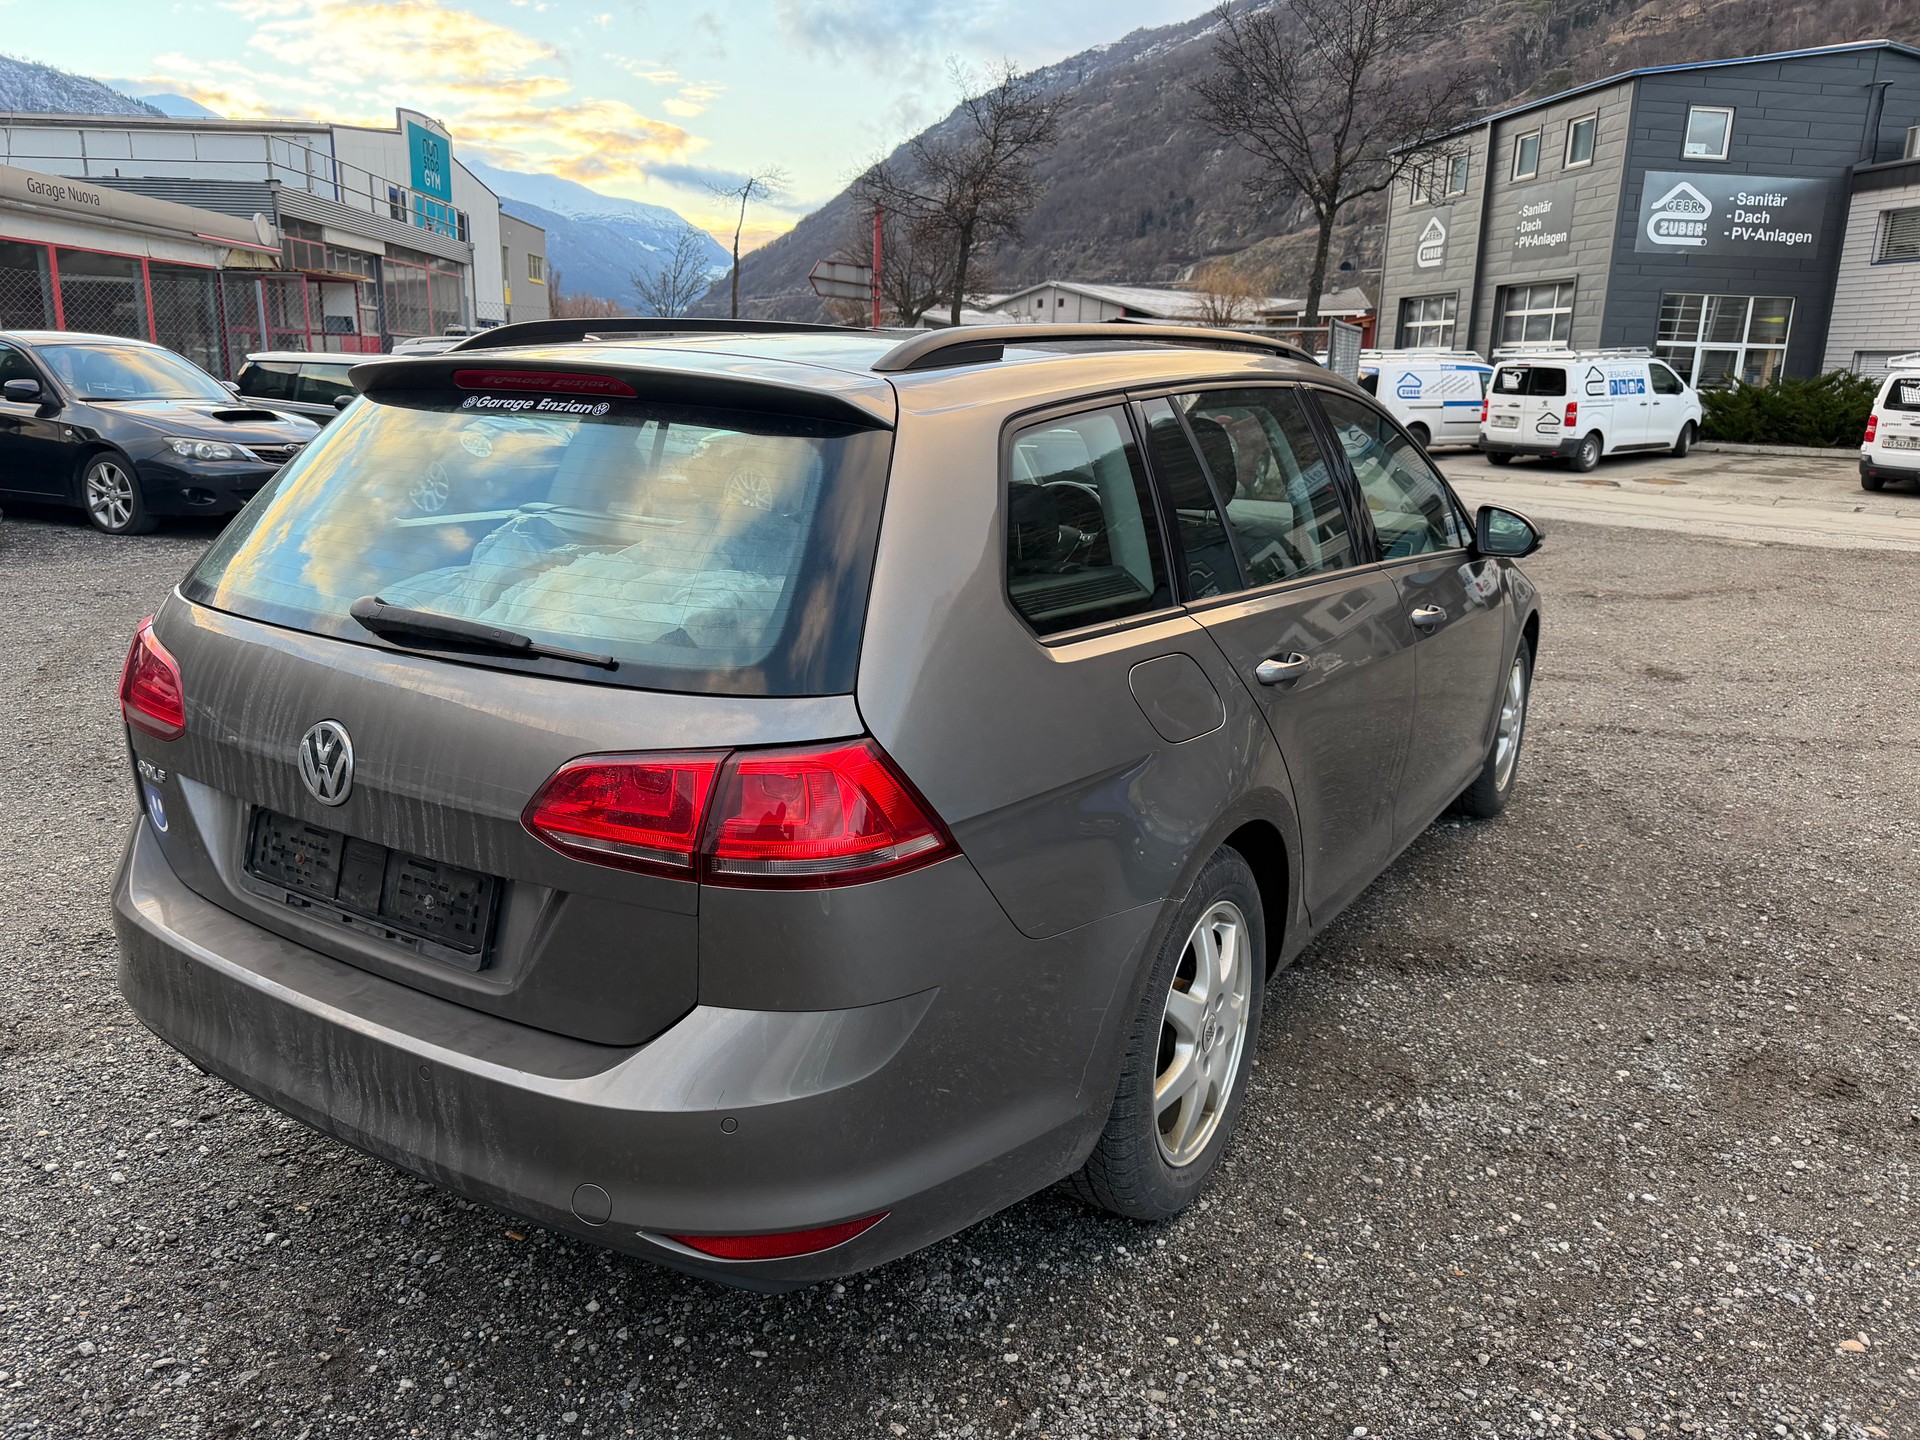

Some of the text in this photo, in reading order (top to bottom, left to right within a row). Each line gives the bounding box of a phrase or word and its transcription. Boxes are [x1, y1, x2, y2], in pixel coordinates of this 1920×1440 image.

[27, 177, 100, 206] Garage Nuova
[424, 170, 441, 191] GYM
[477, 396, 533, 412] Garage
[536, 398, 594, 414] Enzian
[138, 760, 167, 783] GOLF
